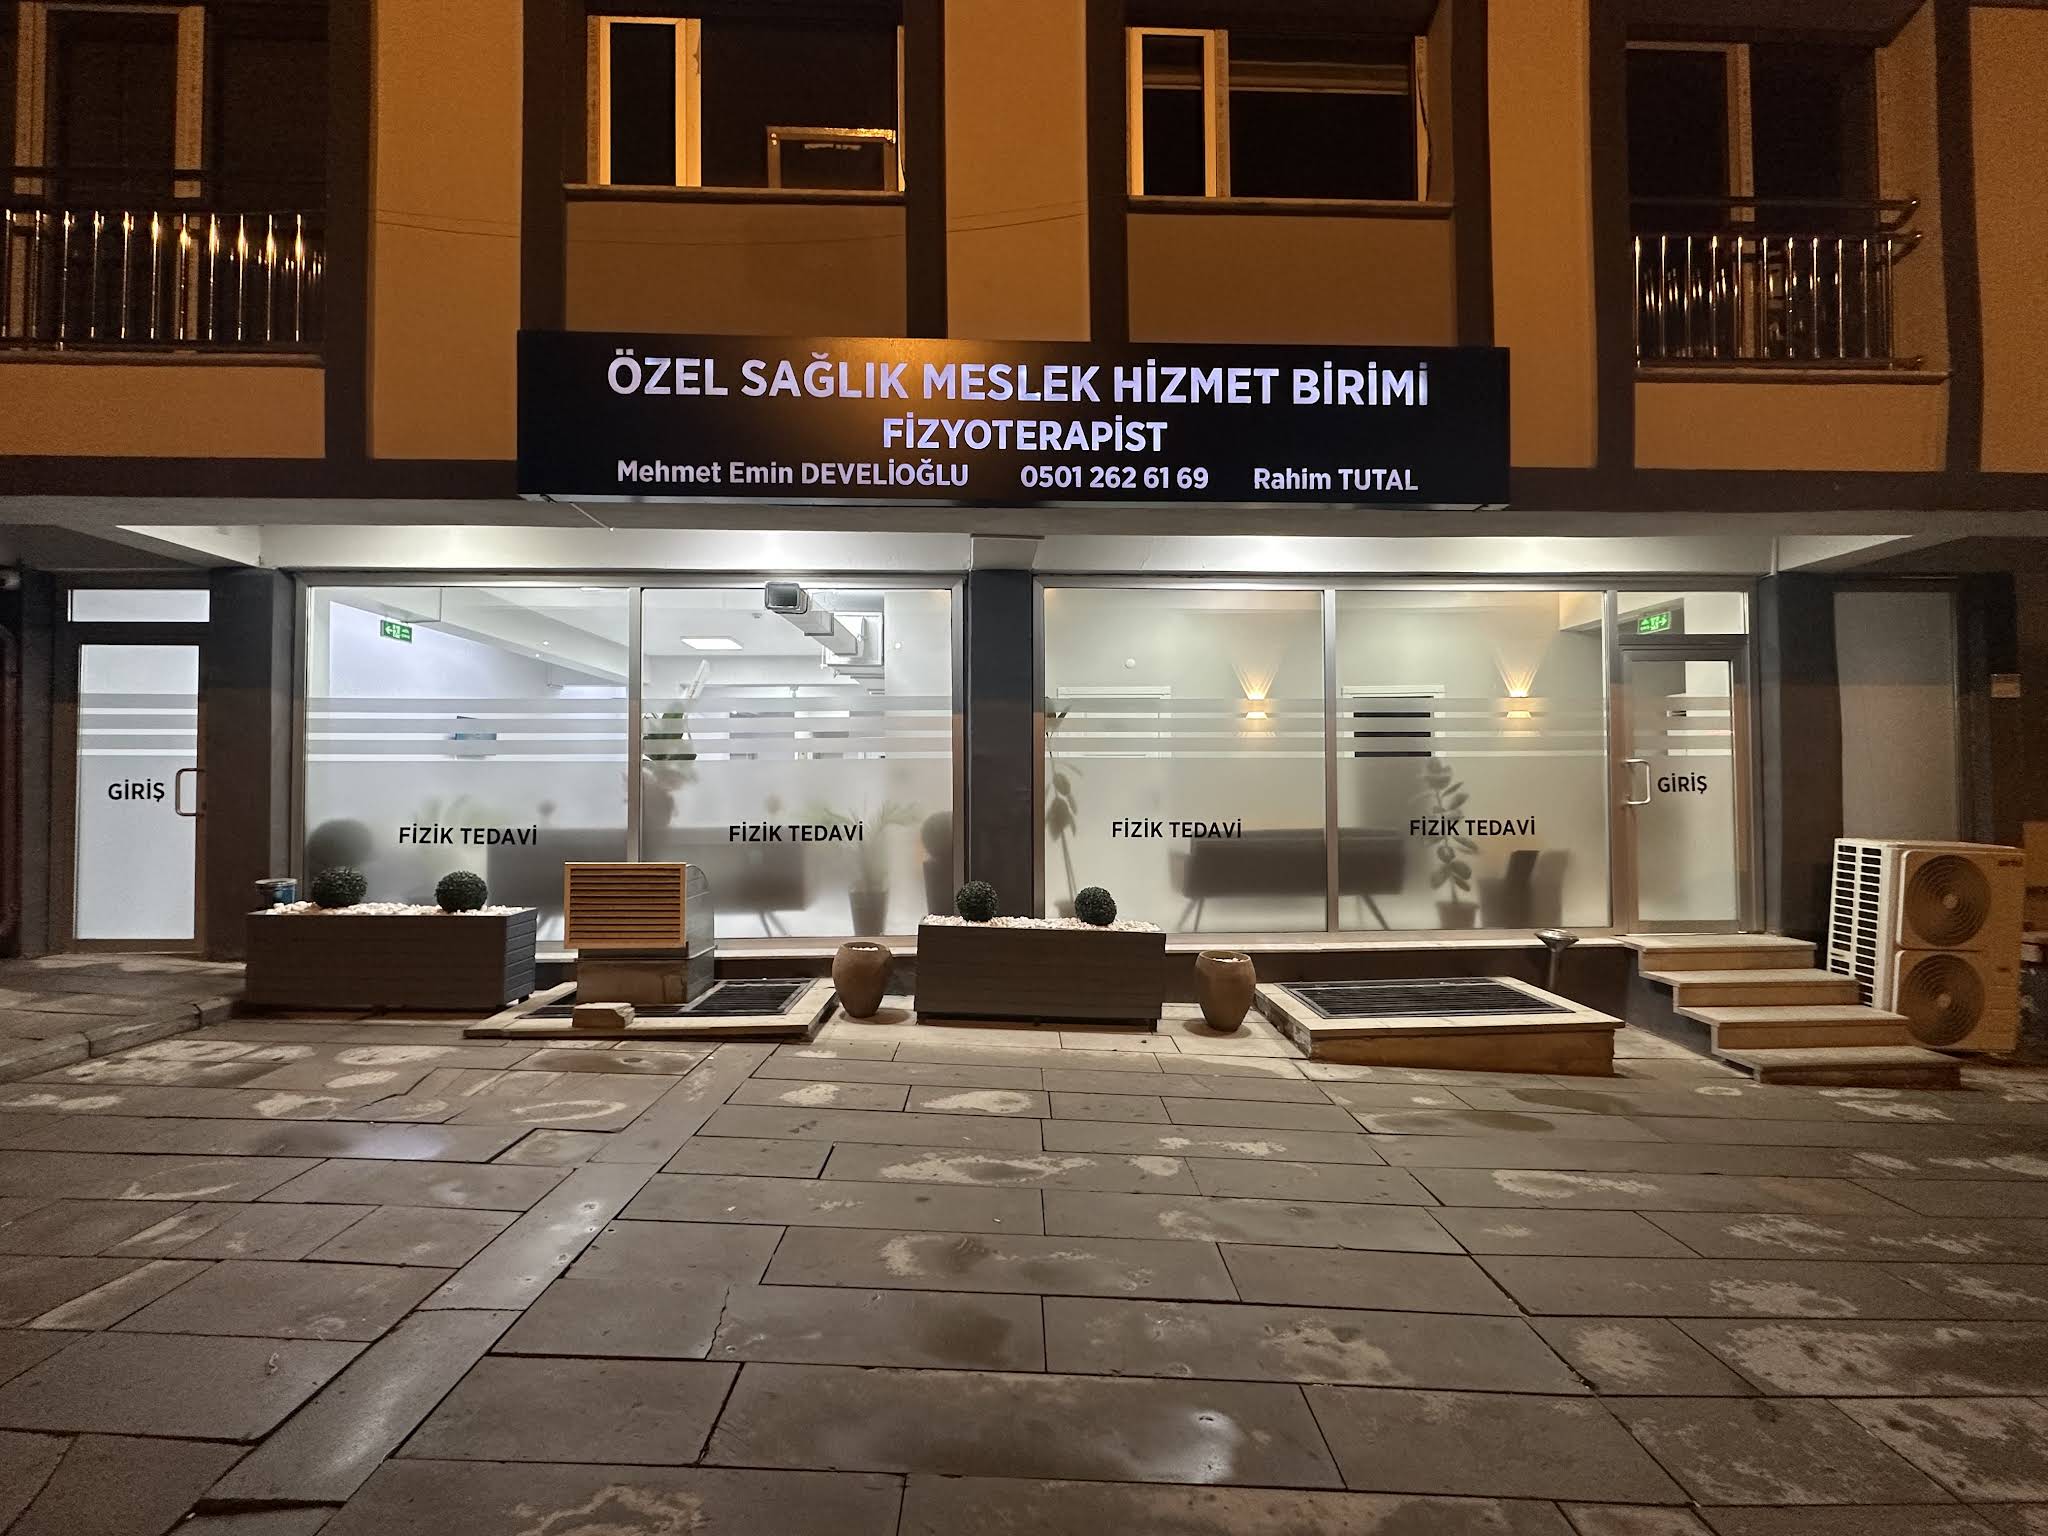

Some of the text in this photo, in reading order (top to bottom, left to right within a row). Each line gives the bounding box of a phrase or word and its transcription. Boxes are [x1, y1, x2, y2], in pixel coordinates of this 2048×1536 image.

[606, 347, 1429, 407] ÖZEL SAĞLIK MESLEK HİZMET BİRİMİ
[882, 412, 1167, 454] FİZYOTERAPİST
[617, 458, 970, 488] Mehmet Emin DEVELİOĞLU
[1020, 464, 1210, 491] 0501 262 61 69
[1253, 467, 1420, 492] Rahim TUTAL
[108, 778, 165, 803] GİRİŞ
[1657, 772, 1708, 795] GİRİŞ
[399, 823, 537, 846] FİZİK TEDAVİ
[729, 821, 864, 843] FİZİK TEDAVİ
[1112, 817, 1242, 839] FİZİK TEDAVİ
[1409, 815, 1536, 837] FİZİK TEDAVİ
